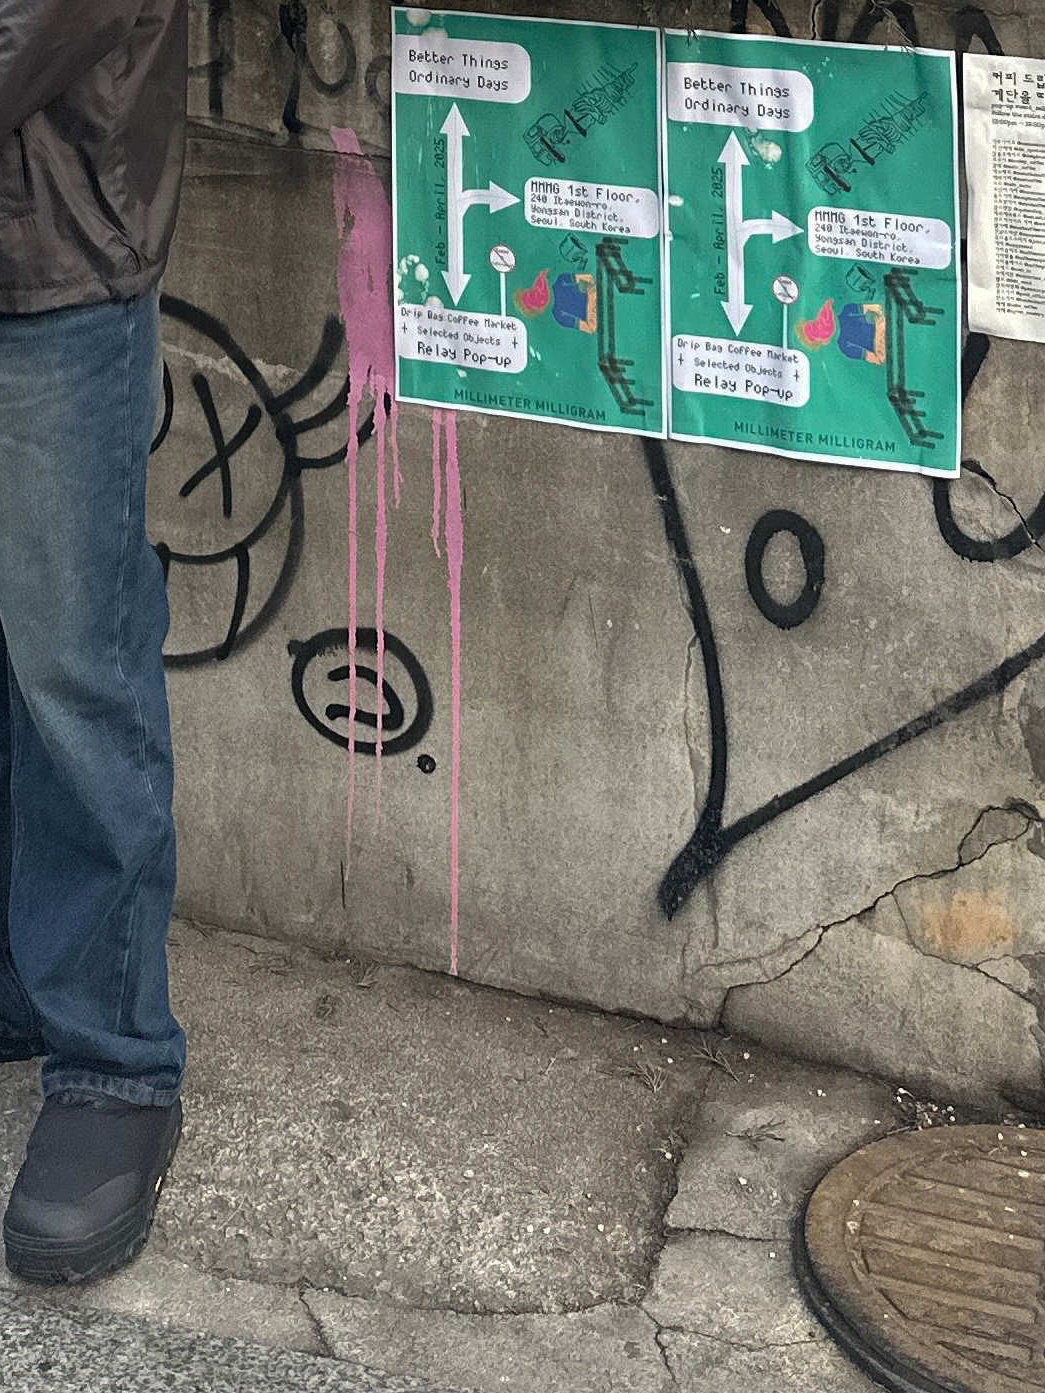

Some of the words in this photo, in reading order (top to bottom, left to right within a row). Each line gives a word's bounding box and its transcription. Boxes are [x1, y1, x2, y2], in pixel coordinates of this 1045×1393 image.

[408, 49, 455, 65] Better
[462, 53, 509, 71] Things
[409, 70, 470, 88] Ordinary
[477, 75, 509, 91] Days
[683, 77, 732, 93] Better
[740, 82, 790, 99] Things
[992, 70, 1017, 86] 커피
[991, 88, 1031, 105] 계단을
[684, 97, 749, 117] Ordinary
[757, 104, 791, 120] Days
[433, 137, 445, 169] 2025
[531, 180, 560, 194] MMMG
[567, 185, 589, 198] 1st
[711, 166, 723, 199] 2025
[531, 193, 548, 203] 240
[530, 204, 569, 217] Yongsan
[814, 210, 846, 224] MMMG
[853, 214, 876, 227] 1st
[569, 219, 597, 230] South
[602, 222, 631, 234] Korea
[815, 223, 833, 233] 240
[815, 233, 856, 246] Yongsan
[434, 241, 446, 265] Feb
[855, 248, 885, 261] South
[890, 252, 920, 265] Korea
[714, 272, 726, 296] Feb
[401, 308, 423, 319] Drip
[427, 310, 444, 322] Bag
[447, 313, 479, 326] Coffee
[484, 318, 517, 331] Market
[417, 325, 459, 340] Selected
[463, 332, 501, 346] Objects
[417, 341, 456, 360] Relay
[463, 348, 512, 368] Pop-up
[677, 338, 700, 349] Drip
[705, 341, 723, 353] Bag
[727, 344, 762, 357] Coffee
[767, 349, 799, 364] Market
[694, 357, 740, 372] Selected
[745, 363, 783, 379] Objects
[694, 373, 737, 392] Relay
[745, 379, 793, 401] Pop-up
[454, 389, 531, 409] MILLIMETER
[535, 399, 606, 421] MILLIGRAM
[734, 421, 813, 444] MILLIMETER
[818, 434, 895, 452] MILLIGRAM
